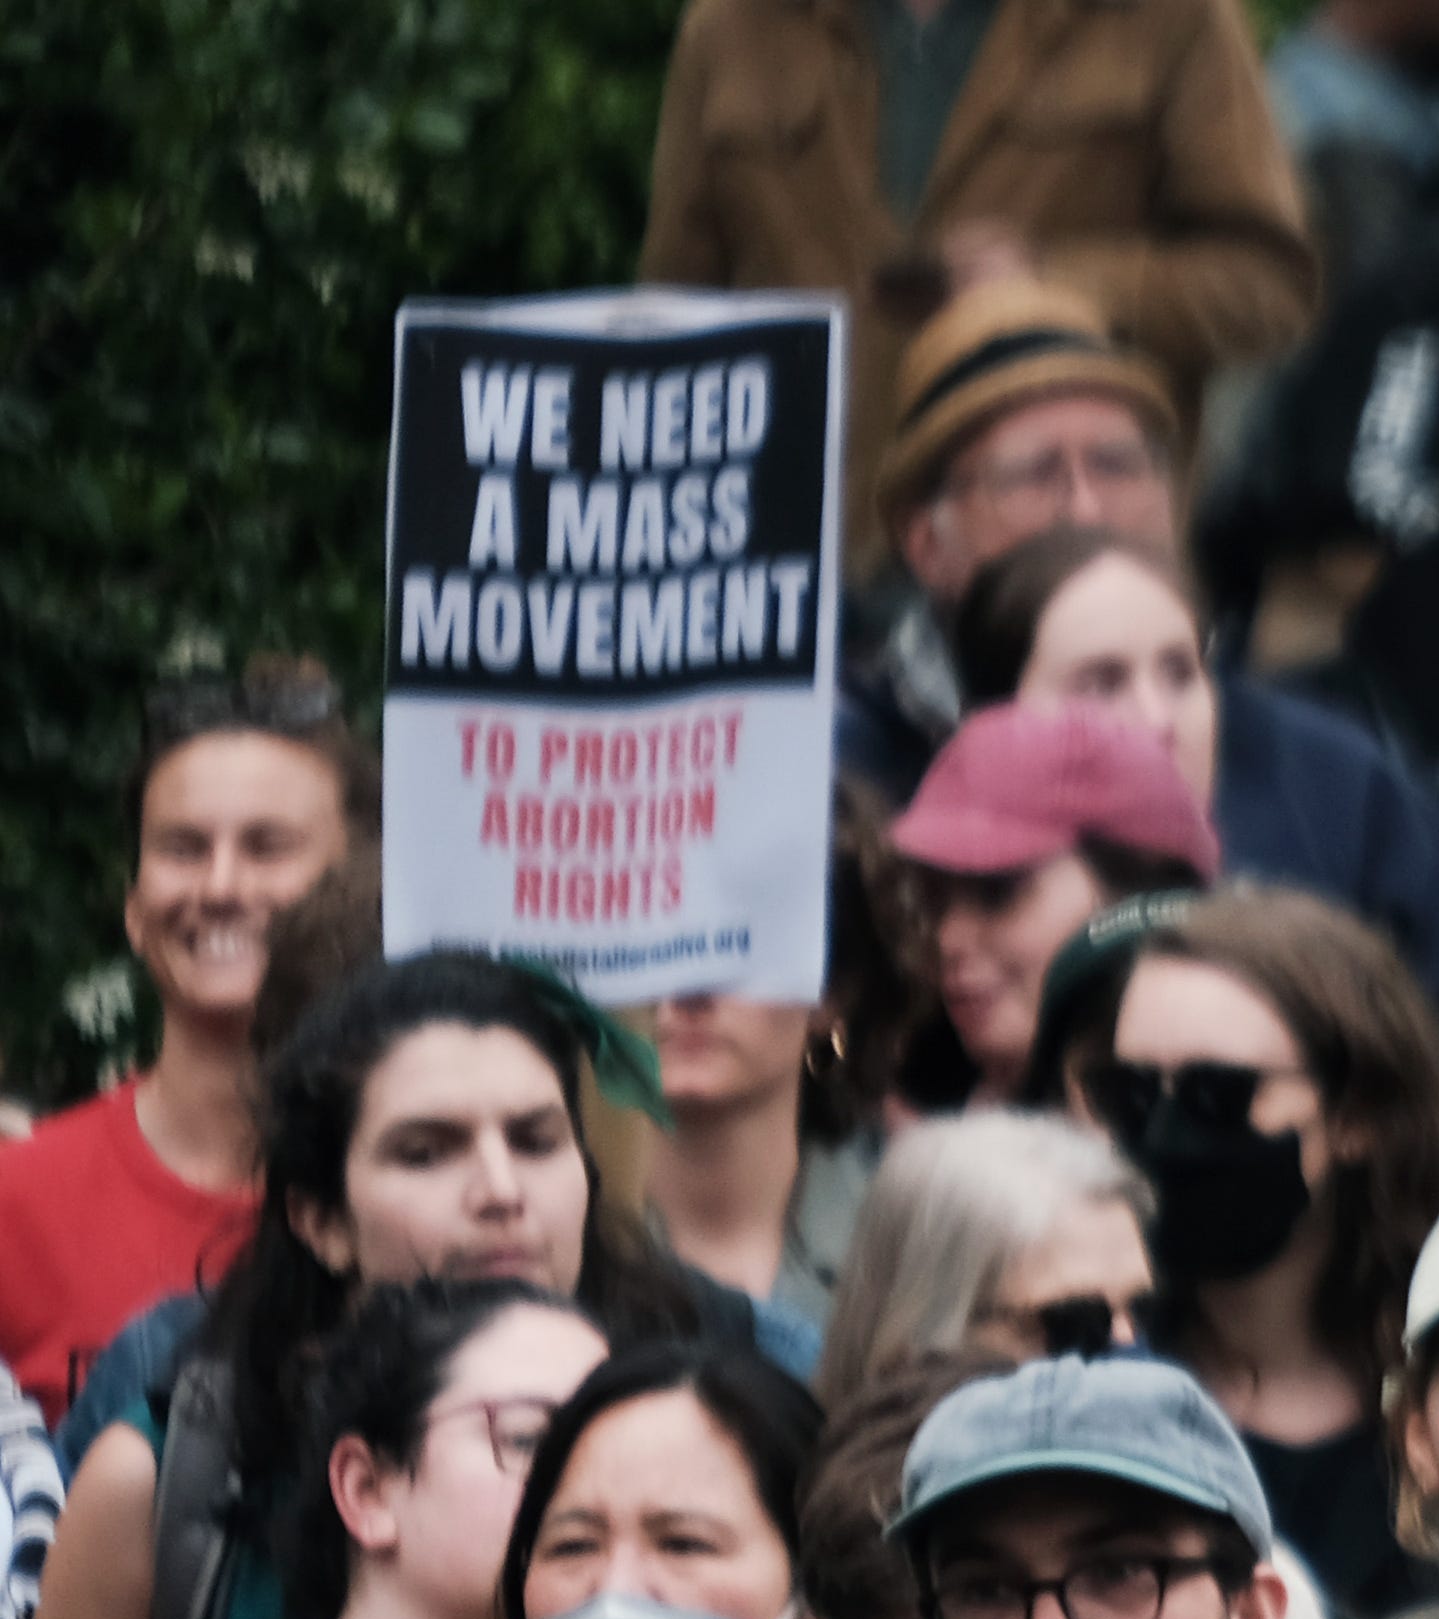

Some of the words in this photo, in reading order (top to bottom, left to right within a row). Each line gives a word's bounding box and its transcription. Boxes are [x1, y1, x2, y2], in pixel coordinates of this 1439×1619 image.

[461, 358, 571, 472] WE
[600, 352, 771, 476] NEED
[469, 472, 517, 572] A
[546, 462, 750, 575] MASS
[401, 560, 812, 678] MOVEMENT
[457, 716, 517, 780] TO
[539, 705, 743, 787] PROTECT
[480, 786, 716, 854] ABORTION
[514, 855, 682, 924] RIGHTS
